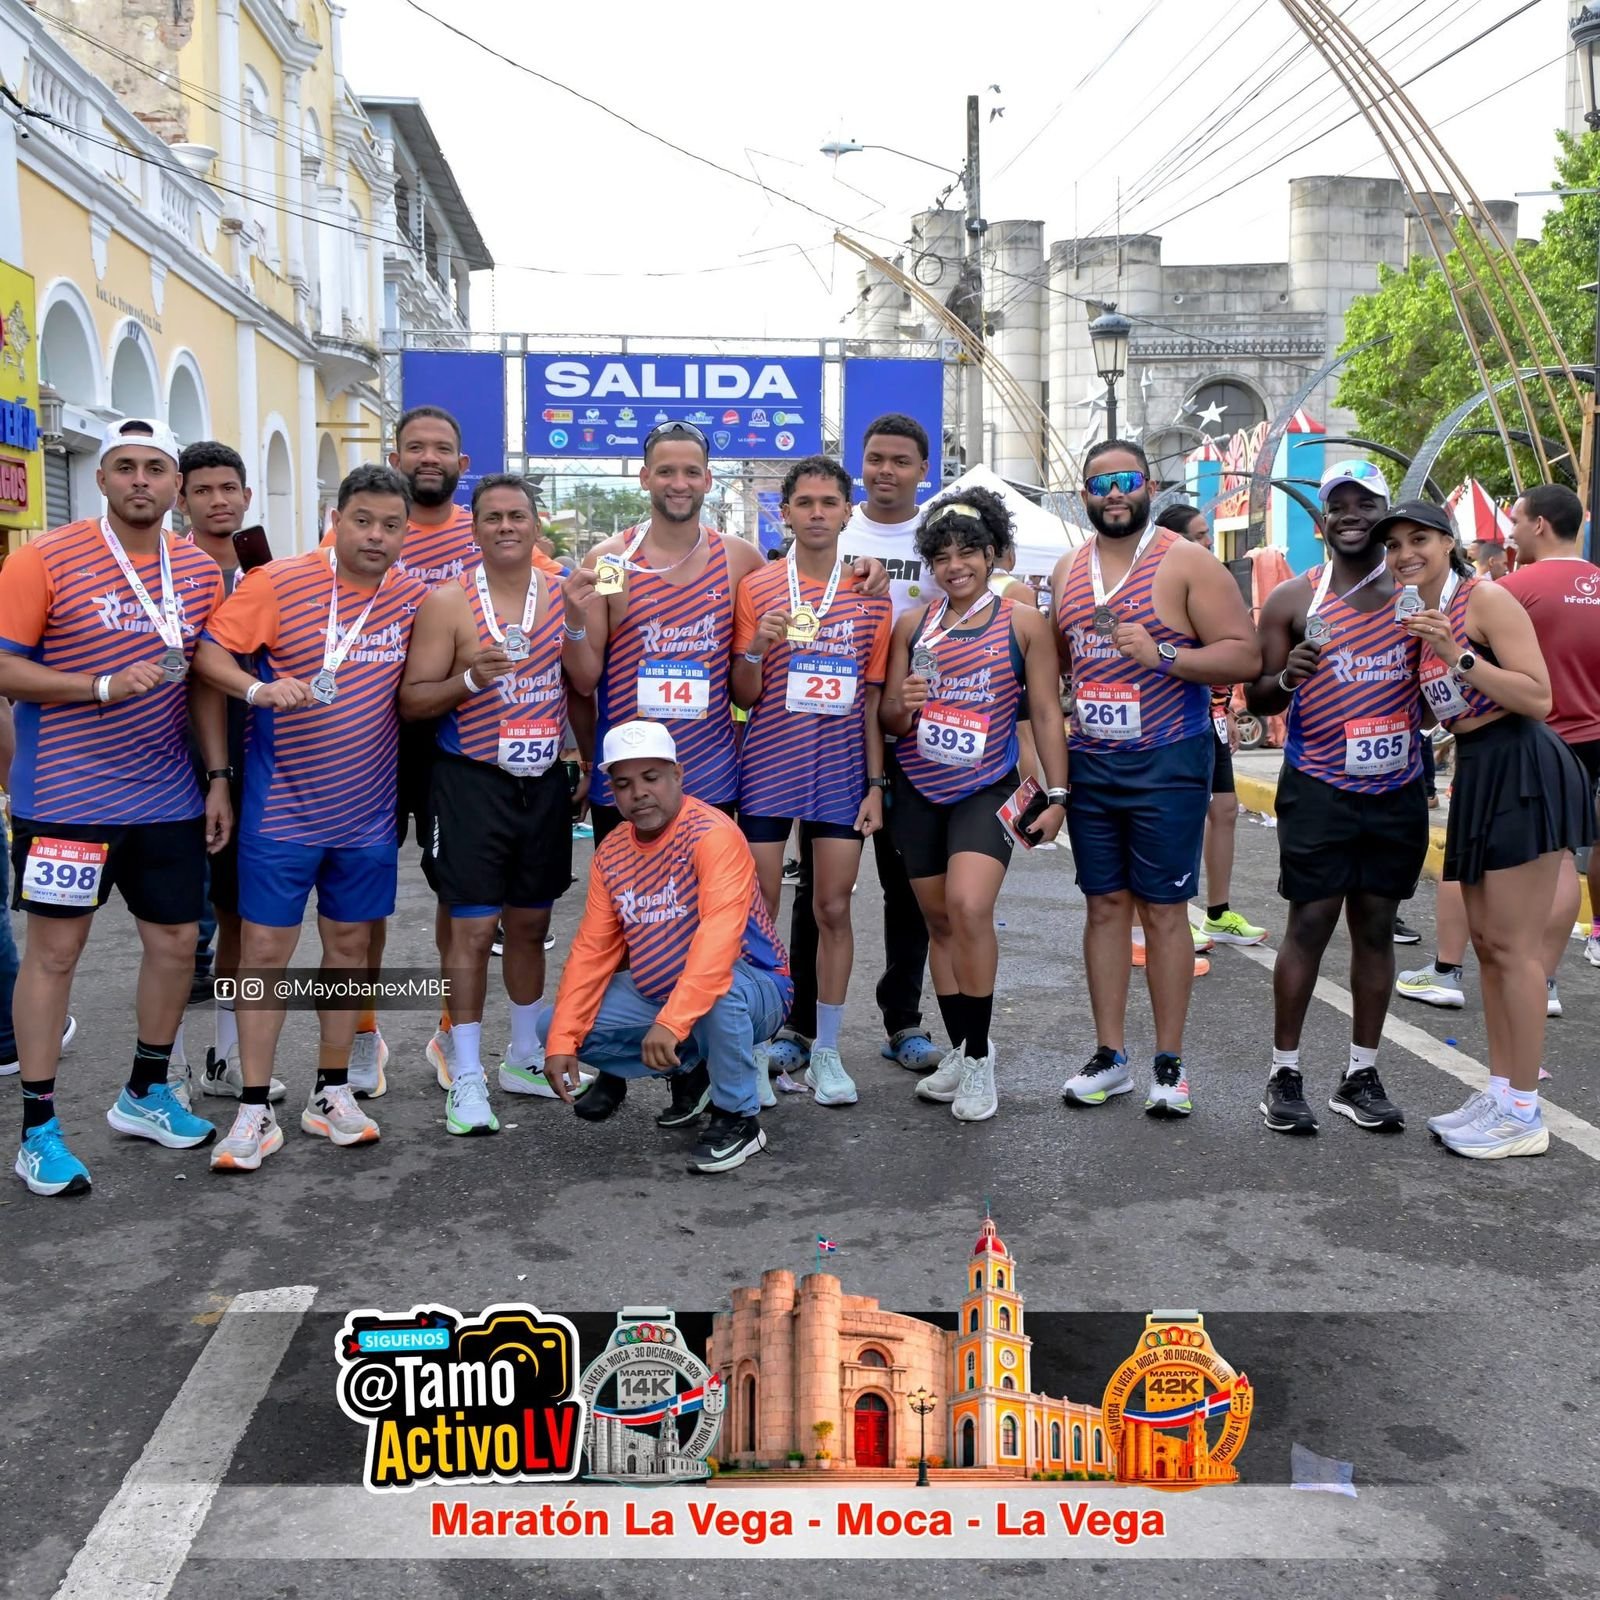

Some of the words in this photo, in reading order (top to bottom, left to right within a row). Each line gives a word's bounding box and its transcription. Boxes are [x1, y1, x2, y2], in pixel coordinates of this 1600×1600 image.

[545, 361, 798, 399] SALIDA
[0, 462, 26, 502] GOS
[408, 563, 451, 582] oyal
[1564, 595, 1600, 605] InFerDo
[638, 624, 700, 641] Royal
[1065, 630, 1115, 646] Roya
[343, 648, 407, 662] unners
[644, 638, 720, 653] Runners
[1327, 650, 1391, 670] Royal
[493, 669, 552, 691] Royal
[1335, 668, 1413, 682] Runners
[659, 681, 692, 703] 14
[805, 677, 841, 700] 23
[1425, 680, 1452, 706] 349
[1084, 703, 1127, 725] 261
[925, 724, 975, 754] 393
[1356, 735, 1403, 761] 365
[507, 740, 554, 763] 254
[34, 861, 96, 890] 398
[615, 892, 668, 909] Royal
